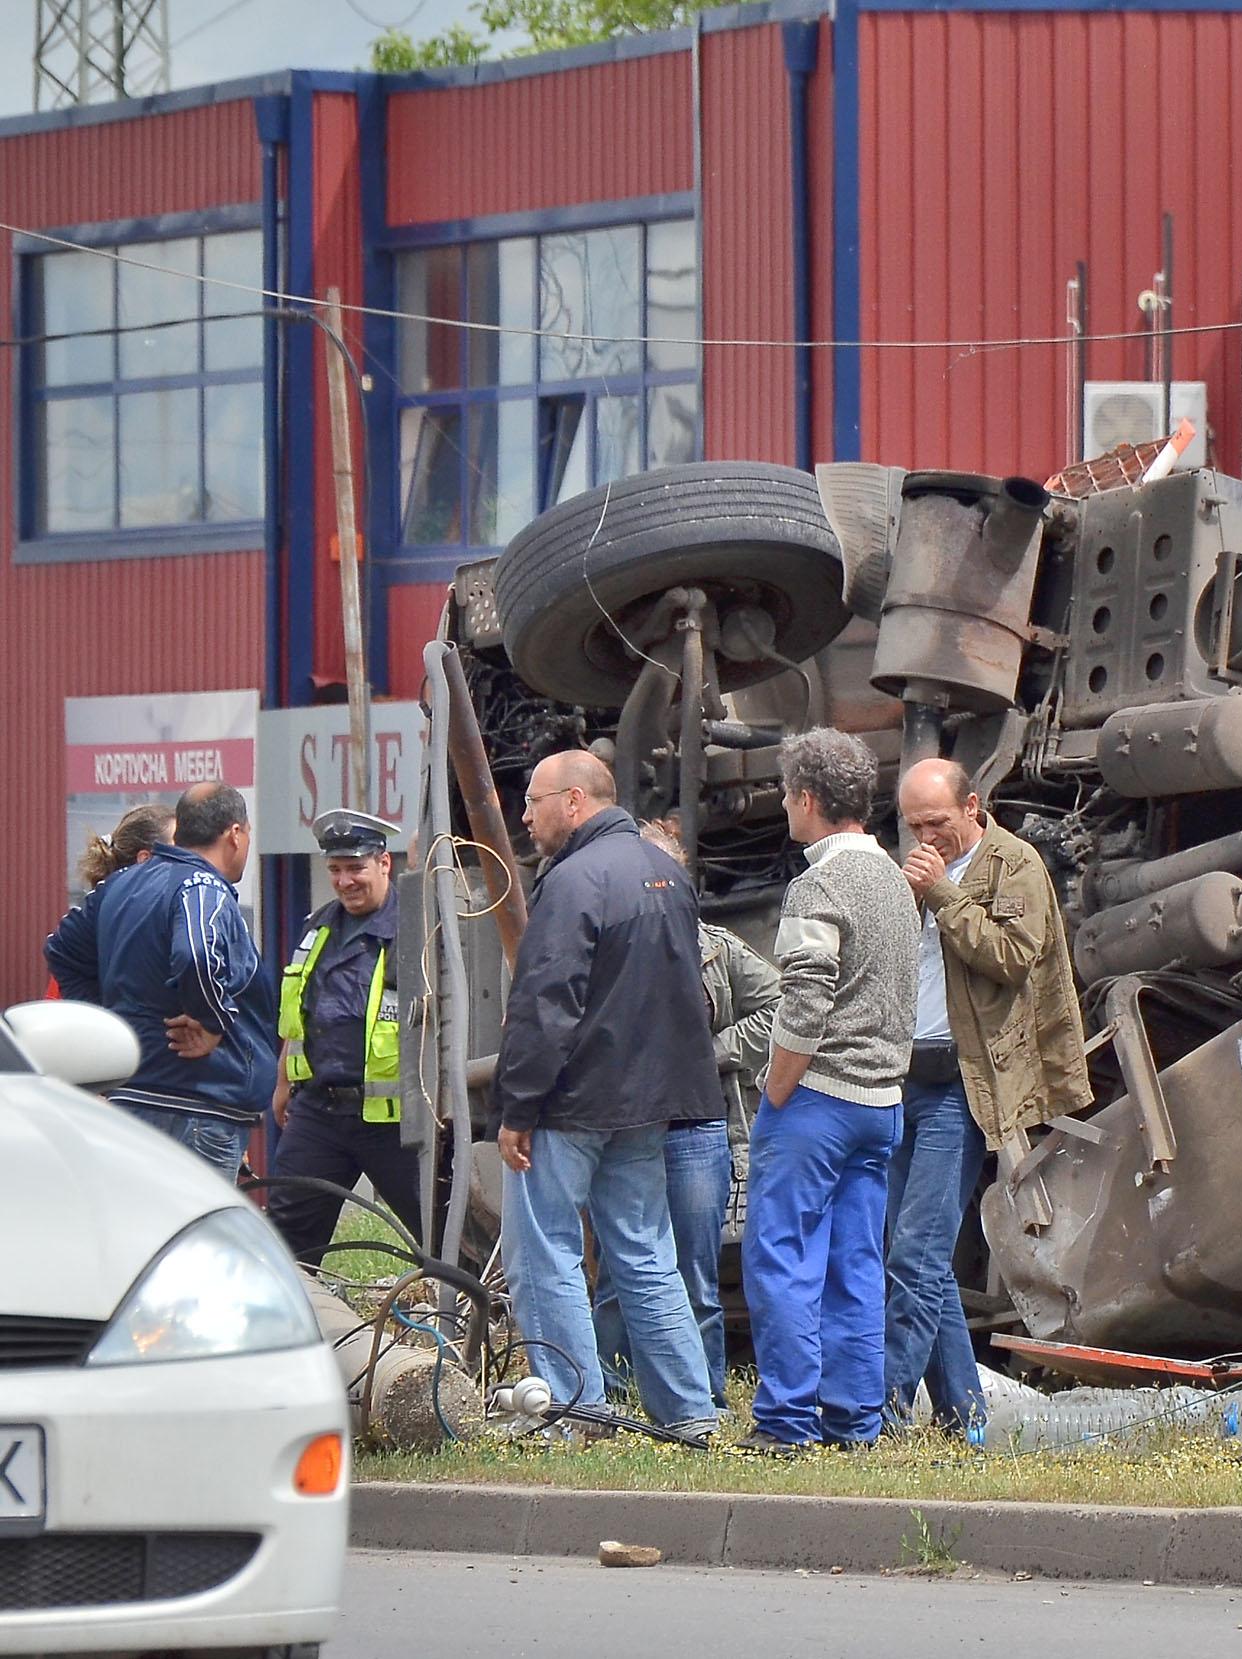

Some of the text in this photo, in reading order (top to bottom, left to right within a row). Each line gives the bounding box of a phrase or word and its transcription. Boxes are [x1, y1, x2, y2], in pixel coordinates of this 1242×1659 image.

[95, 749, 224, 785] КОРПУСНА МЕБЕЛ
[299, 731, 426, 828] STE
